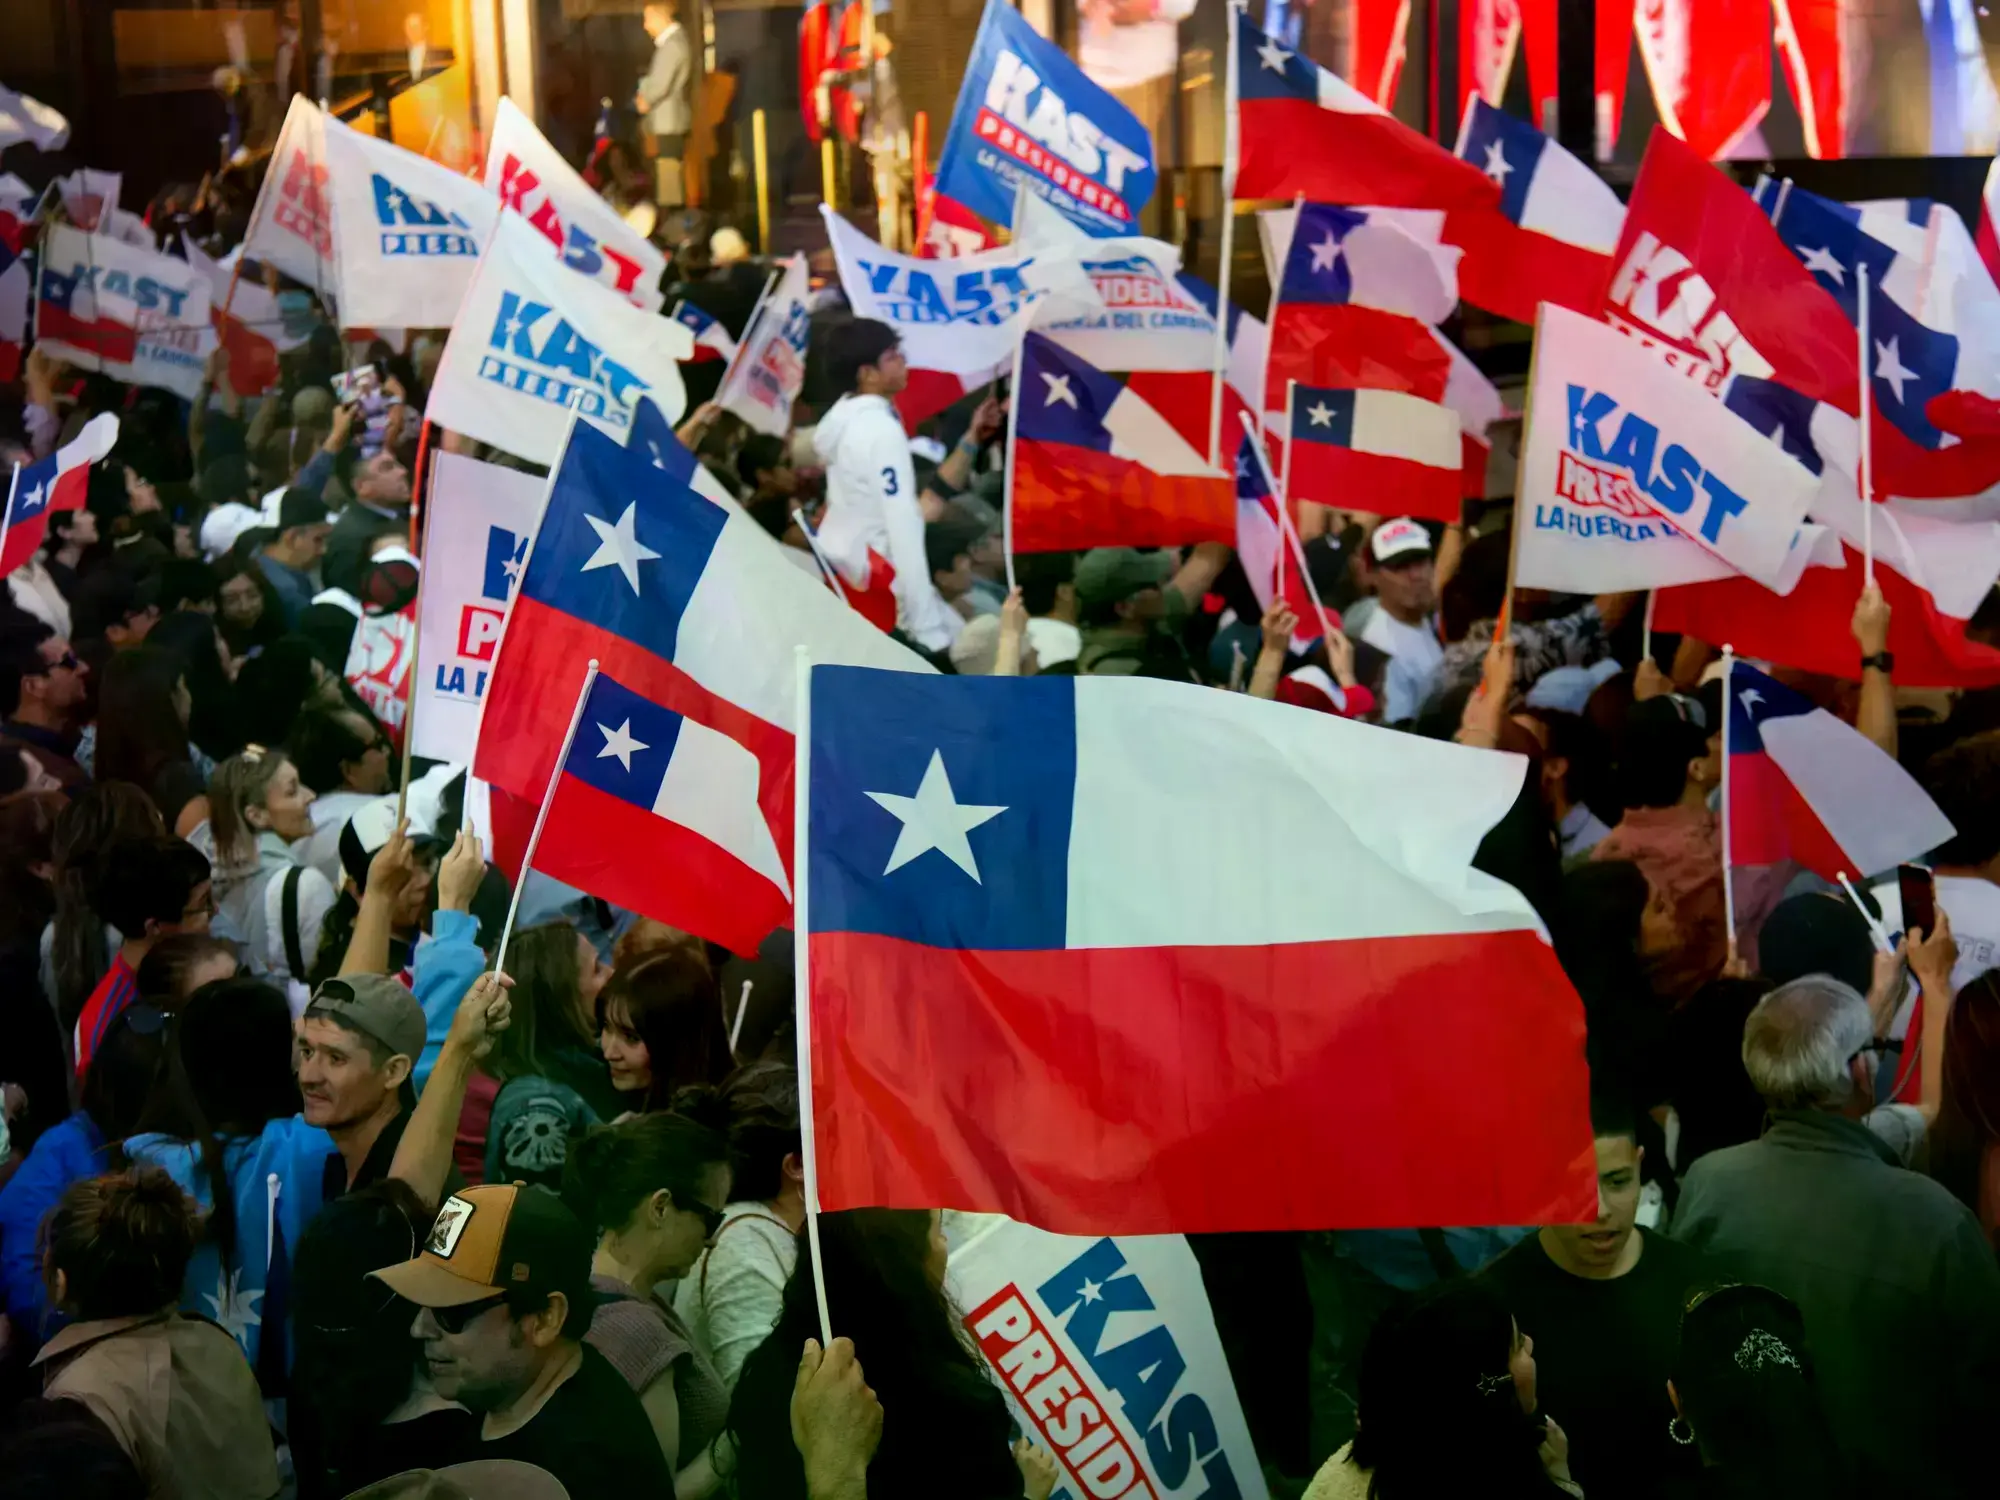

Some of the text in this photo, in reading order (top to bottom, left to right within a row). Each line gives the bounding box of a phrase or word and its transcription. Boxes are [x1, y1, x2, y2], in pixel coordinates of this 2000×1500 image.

[979, 115, 1128, 221] PRESIDENTE
[986, 48, 1149, 193] KAST
[489, 289, 652, 410] KAT
[881, 466, 899, 496] 3
[1567, 384, 1749, 545] KAST
[1535, 505, 1564, 529] LA
[1568, 512, 1656, 542] FUERZA
[435, 664, 465, 693] LA
[1037, 1236, 1244, 1500] KAST
